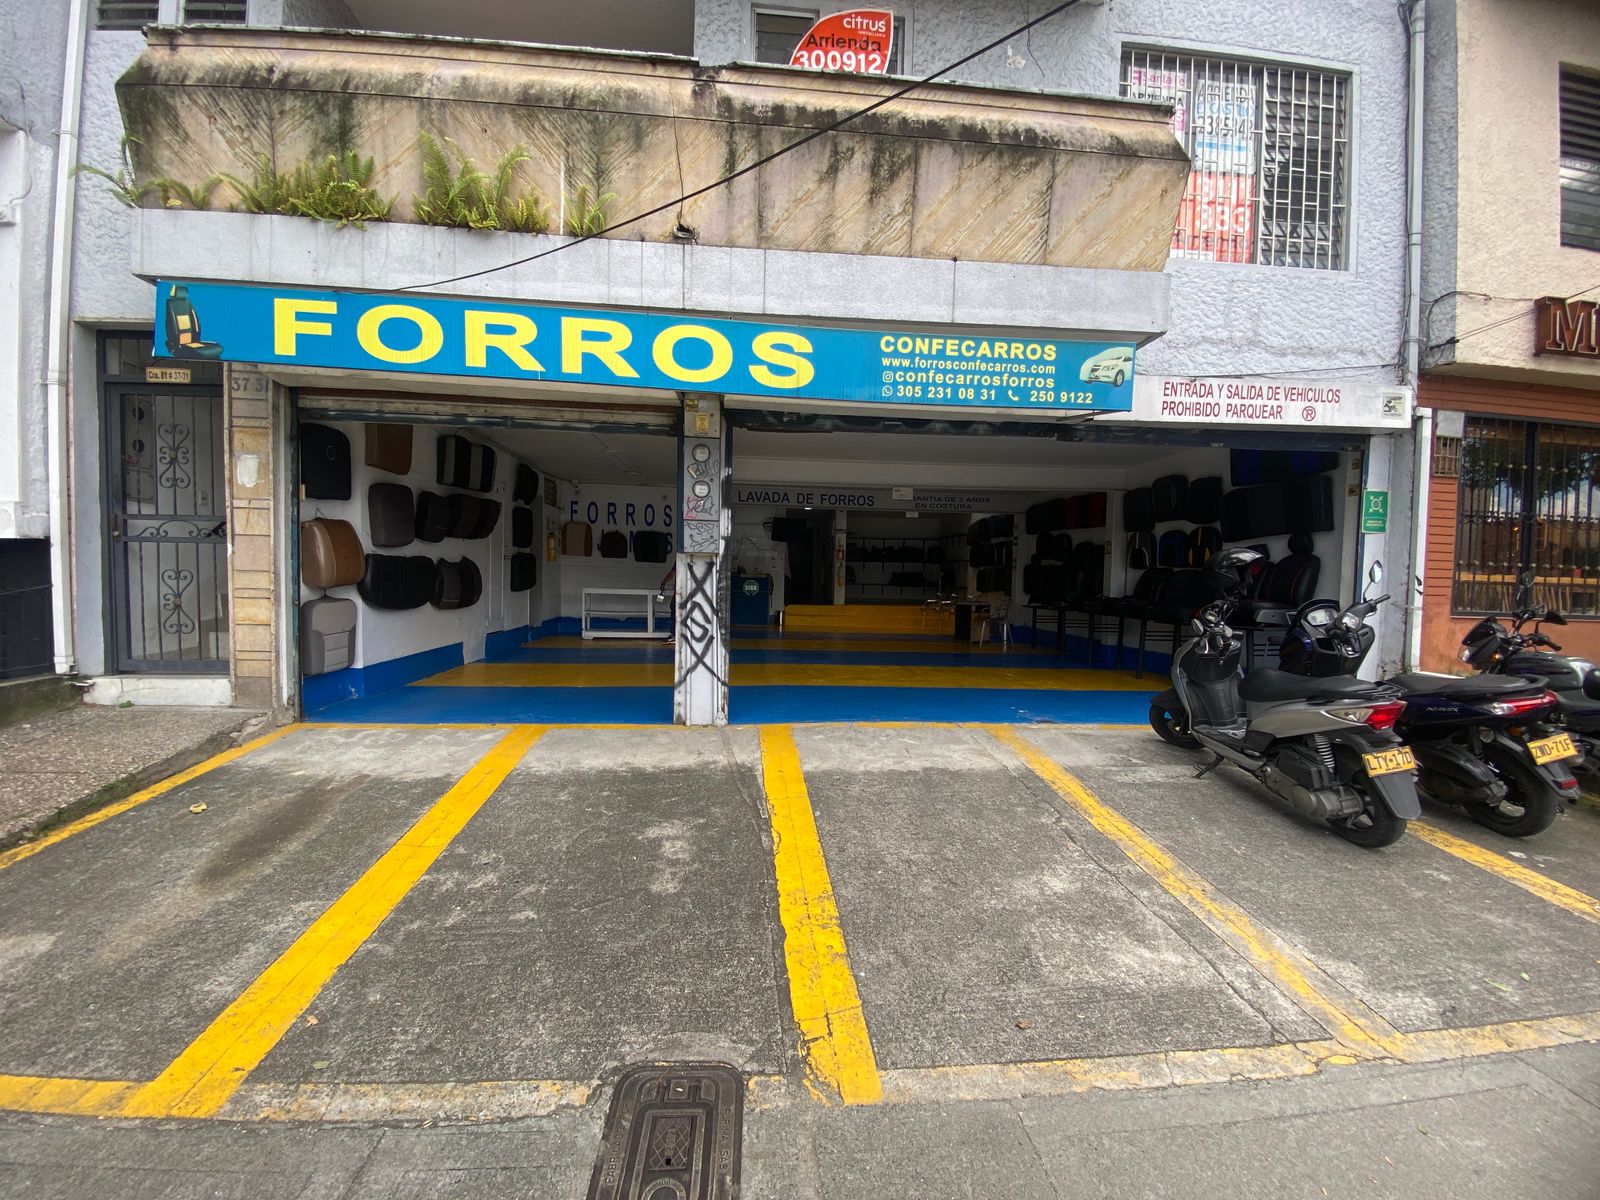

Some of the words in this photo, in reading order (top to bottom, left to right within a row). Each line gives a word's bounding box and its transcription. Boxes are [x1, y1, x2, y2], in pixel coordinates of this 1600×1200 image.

[843, 14, 886, 32] citrus
[806, 33, 882, 52] Arrienda
[275, 299, 814, 388] FORROS
[880, 336, 1057, 361] CONFECARROS
[881, 356, 1056, 374] www.forrosconfecarros.com
[895, 370, 1055, 388] confecarrosforros
[896, 386, 922, 398] 305
[927, 387, 952, 399] 231
[958, 388, 975, 400] 08
[980, 388, 996, 400] 31
[1030, 391, 1055, 402] 250
[1060, 392, 1093, 404] 9122
[1163, 382, 1214, 399] ENTRADA
[1216, 384, 1225, 399] Y
[1226, 385, 1264, 400] SALIDA
[1266, 386, 1280, 401] DE
[1284, 387, 1341, 403] VEHICULOS
[1161, 401, 1221, 417] PROHIBIDO
[1226, 403, 1283, 419] PARQUEAR
[738, 490, 790, 504] LAVADA
[796, 493, 814, 505] DE
[820, 493, 875, 507] FORROS
[570, 500, 673, 527] FORROS
